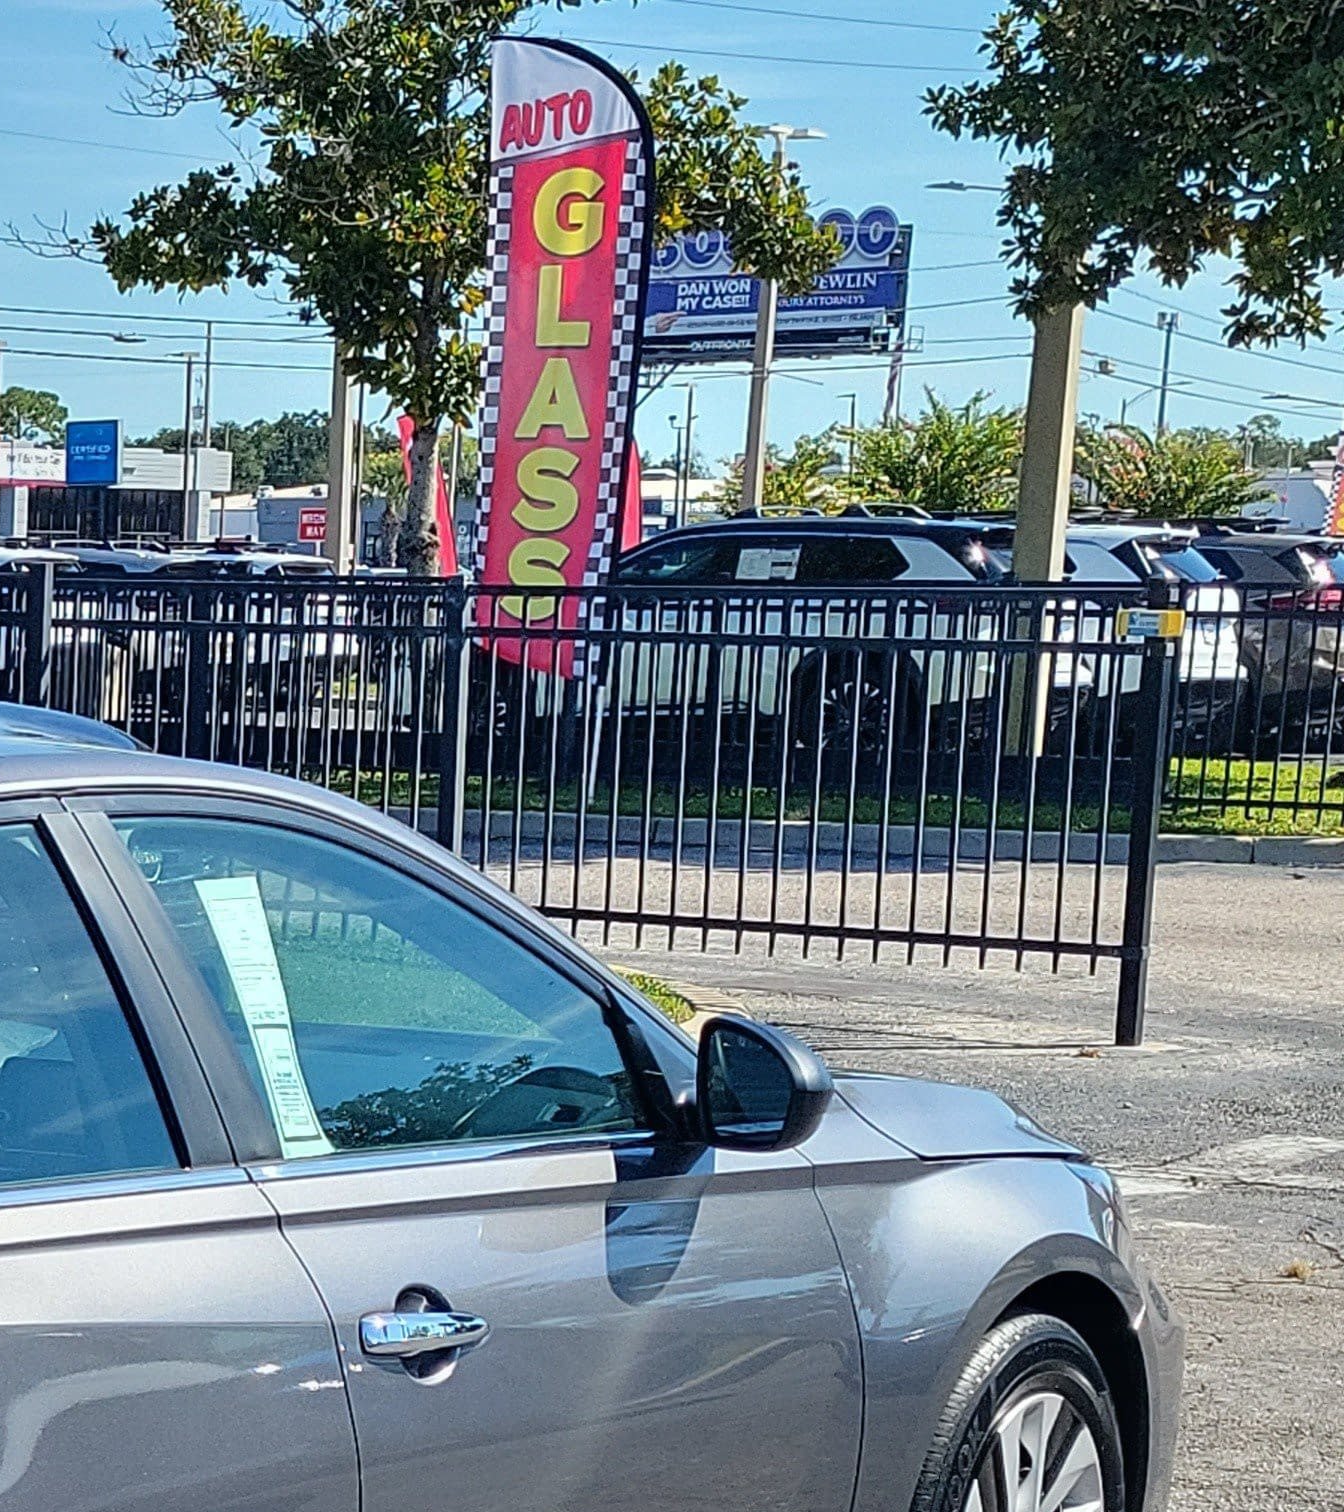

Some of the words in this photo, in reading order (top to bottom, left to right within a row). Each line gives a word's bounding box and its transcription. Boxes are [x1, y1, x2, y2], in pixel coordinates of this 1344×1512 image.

[499, 88, 593, 152] AUTO
[676, 296, 700, 311] MY
[677, 282, 710, 297] DAN
[712, 279, 751, 295] WON
[499, 167, 606, 621] GLASS
